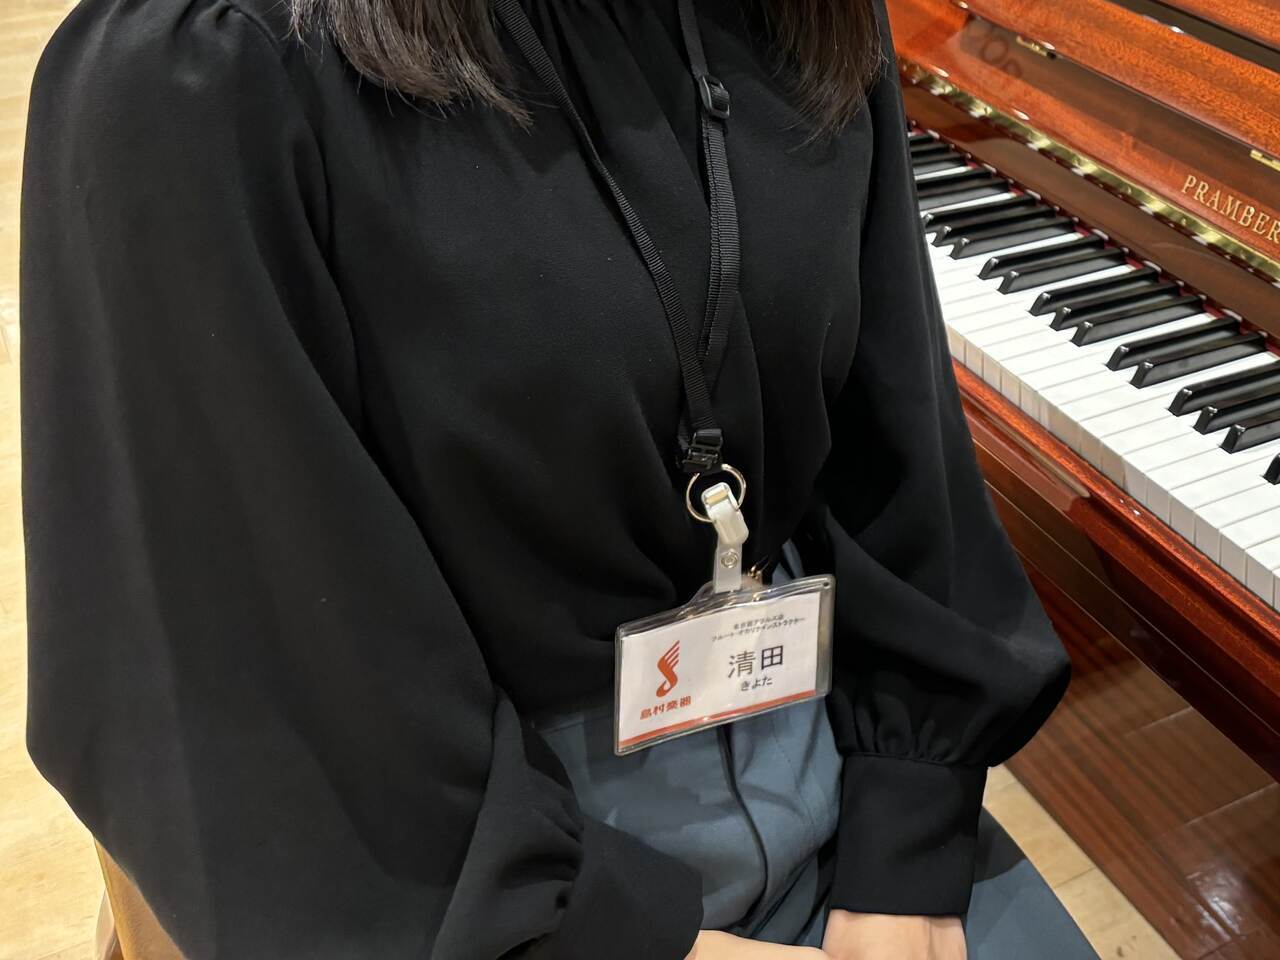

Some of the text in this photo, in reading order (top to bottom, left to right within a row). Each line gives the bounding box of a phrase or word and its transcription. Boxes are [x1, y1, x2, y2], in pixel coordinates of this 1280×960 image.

[727, 644, 784, 679] 清田
[740, 676, 774, 692] きよた
[639, 695, 692, 721] 島村楽器
